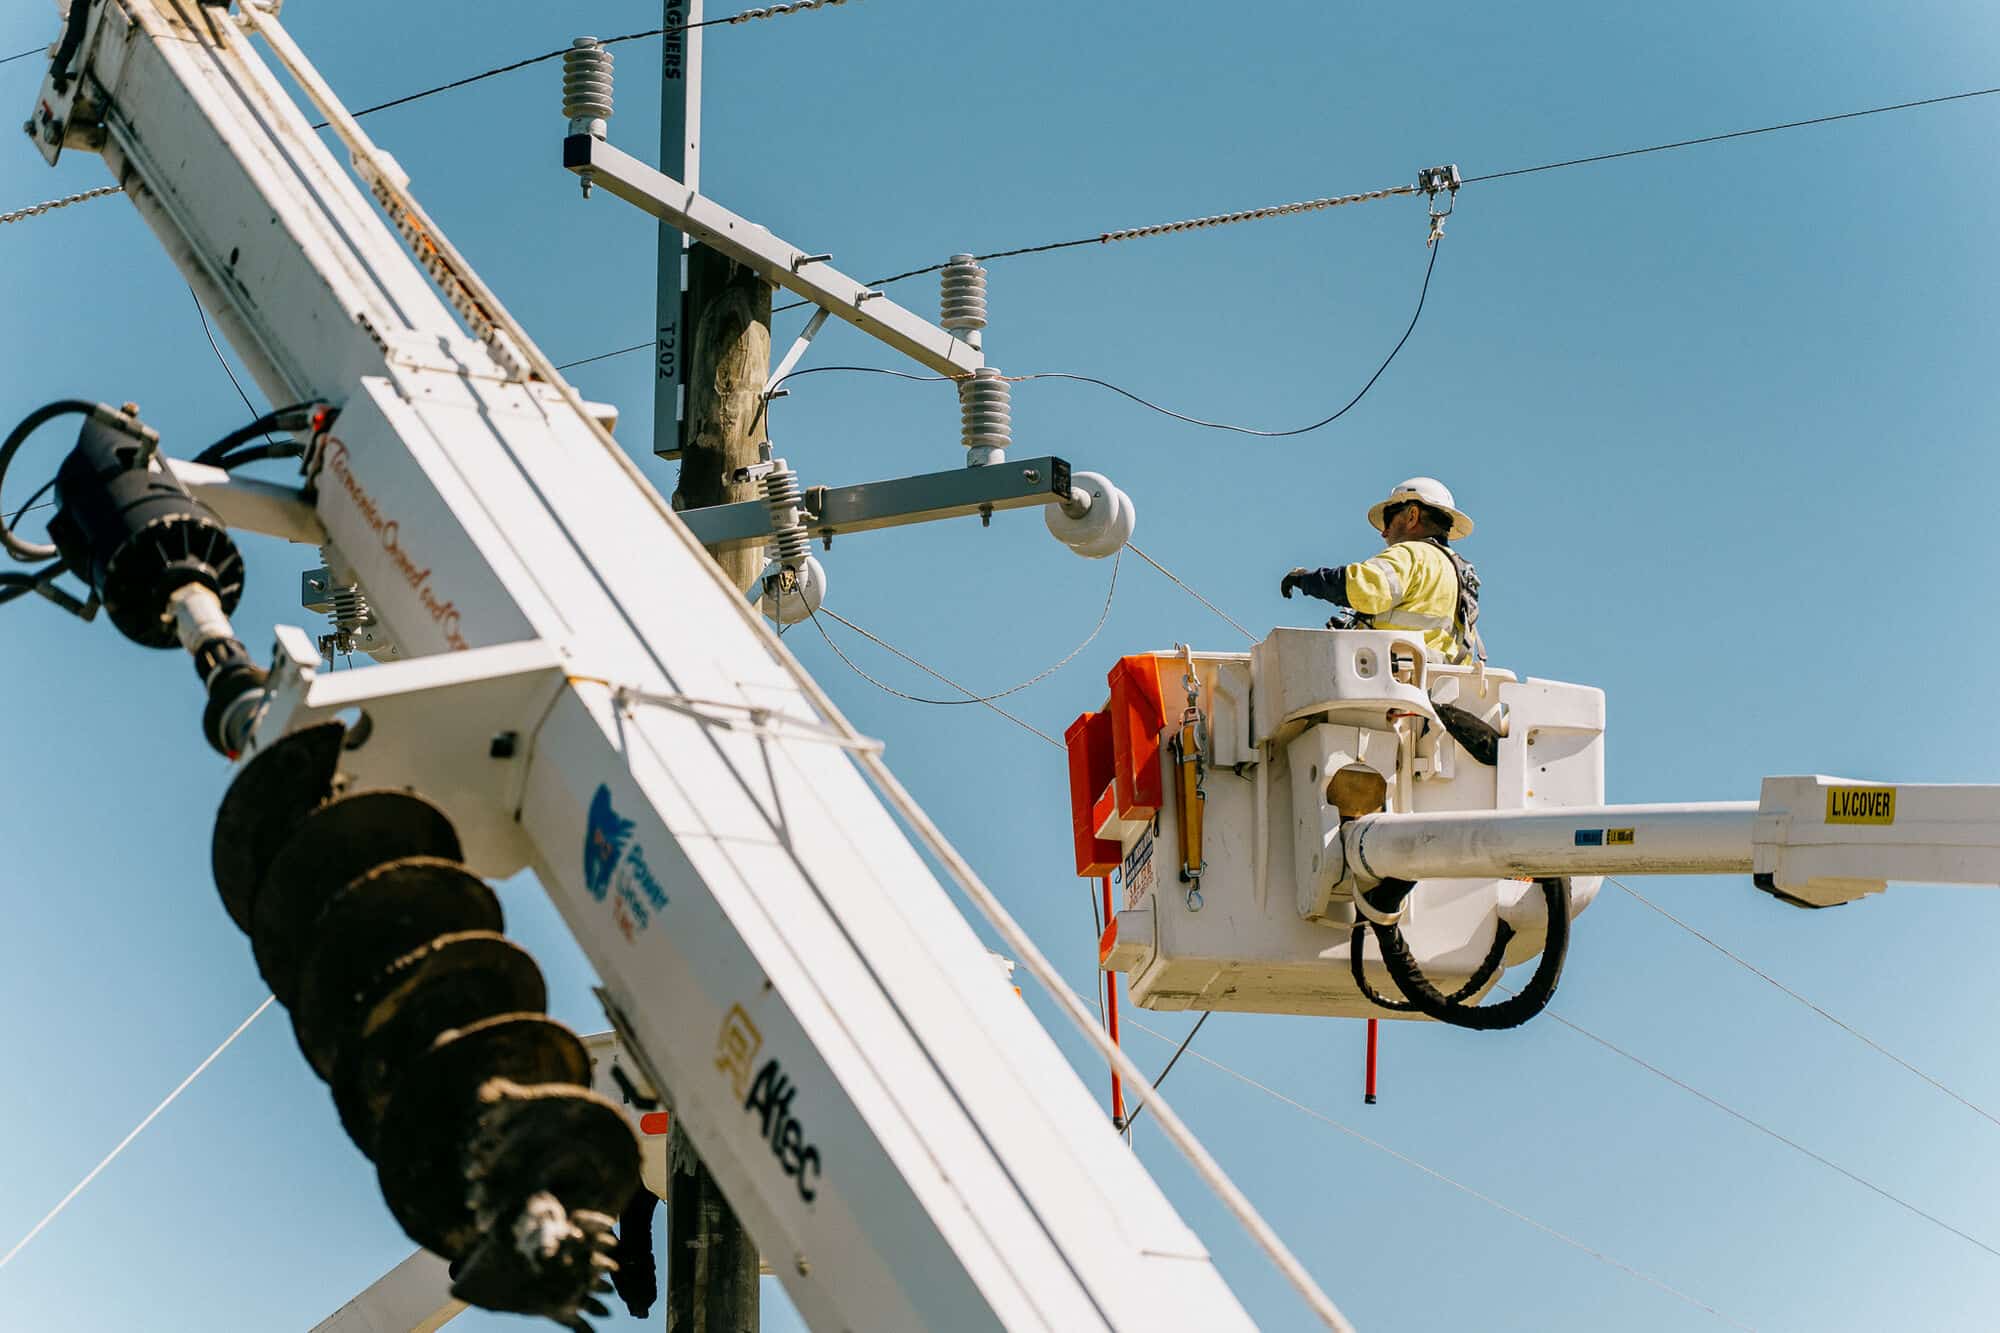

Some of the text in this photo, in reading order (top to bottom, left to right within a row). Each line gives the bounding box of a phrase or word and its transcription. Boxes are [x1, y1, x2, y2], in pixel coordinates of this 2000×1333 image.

[660, 322, 675, 378] T202
[1832, 791, 1890, 817] L.V.COVER
[745, 1058, 822, 1205] Altec
